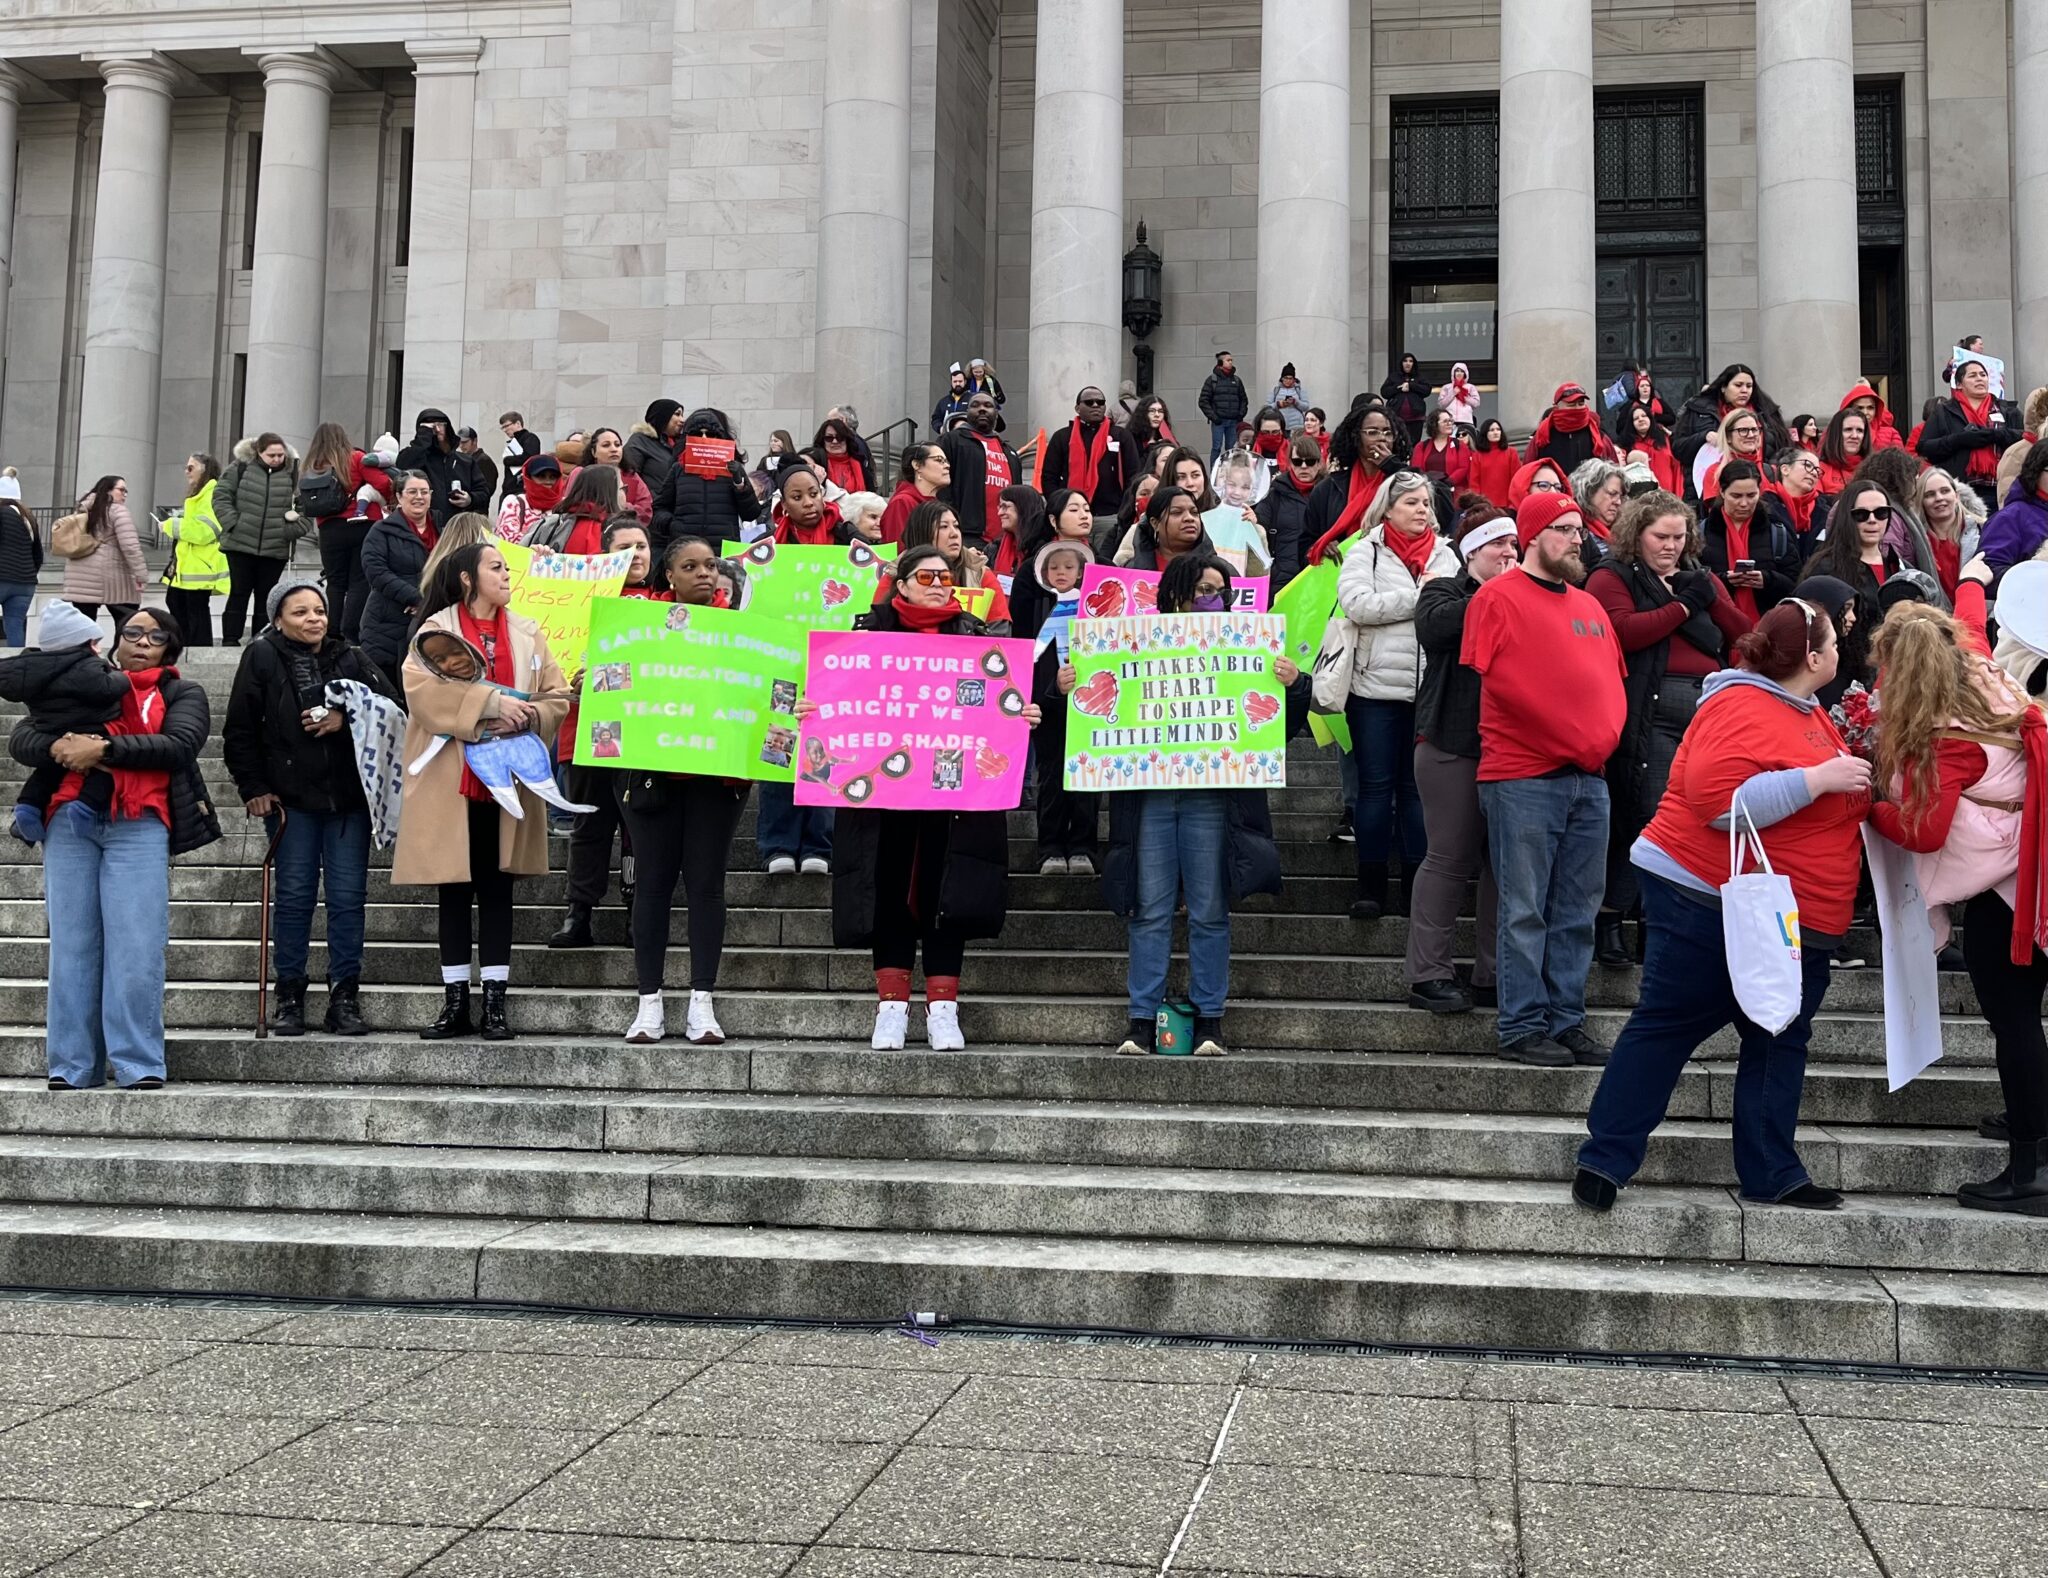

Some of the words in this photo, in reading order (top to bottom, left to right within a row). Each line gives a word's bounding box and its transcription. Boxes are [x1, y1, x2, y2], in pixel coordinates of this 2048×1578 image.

[600, 626, 667, 653] EARLY
[823, 654, 871, 671] OUR
[882, 655, 975, 674] FUTURE
[1121, 661, 1139, 679] IT
[1145, 656, 1206, 676] TAKES
[1211, 655, 1221, 672] A
[1227, 656, 1263, 672] BIG
[639, 663, 764, 689] EDUCATORS
[879, 684, 903, 700] IS
[917, 685, 952, 702] SO
[1142, 677, 1216, 699] HEART
[623, 701, 695, 718] TEACH
[713, 708, 757, 724] AND
[819, 700, 920, 720] BRIGHT
[931, 703, 963, 720] WE
[1139, 703, 1163, 720] TO
[1169, 699, 1235, 719] SHAPE
[657, 732, 718, 750] CARE
[828, 732, 893, 750] NEED
[902, 733, 988, 751] SHADES
[1167, 722, 1238, 743] MINDS
